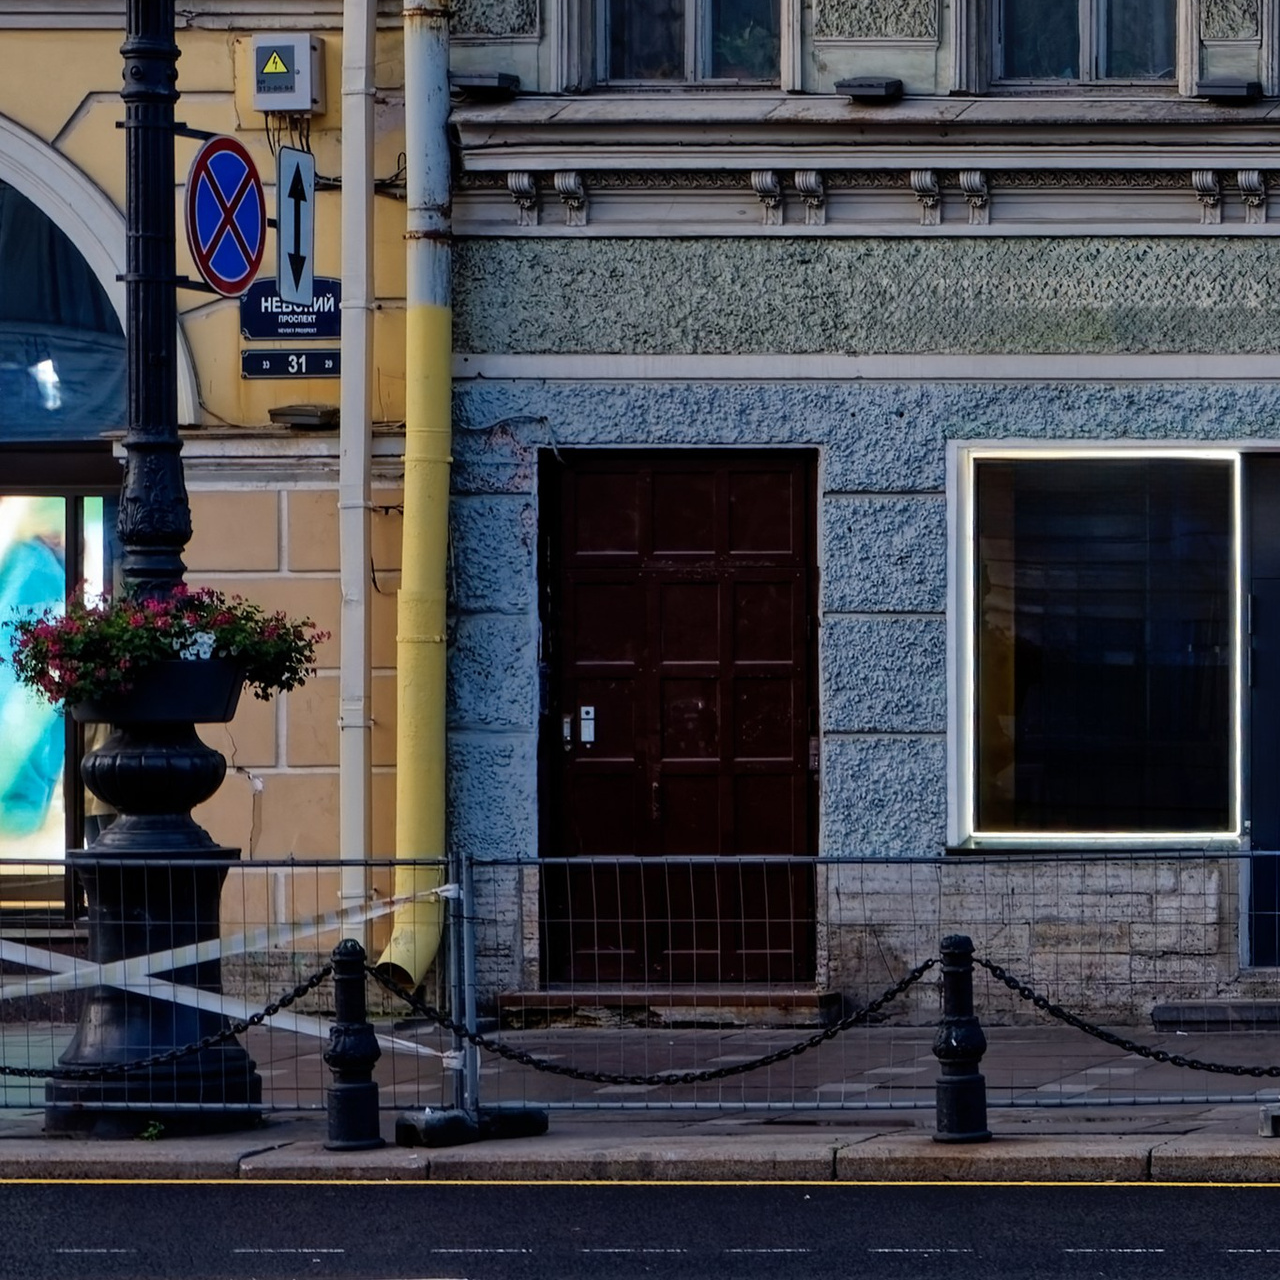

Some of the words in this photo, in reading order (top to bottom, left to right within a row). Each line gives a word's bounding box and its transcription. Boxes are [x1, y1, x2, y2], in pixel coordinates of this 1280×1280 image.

[278, 314, 317, 323] ПРОСПЕКТ
[262, 360, 270, 369] 33
[288, 354, 307, 373] 31
[325, 360, 333, 368] 29
